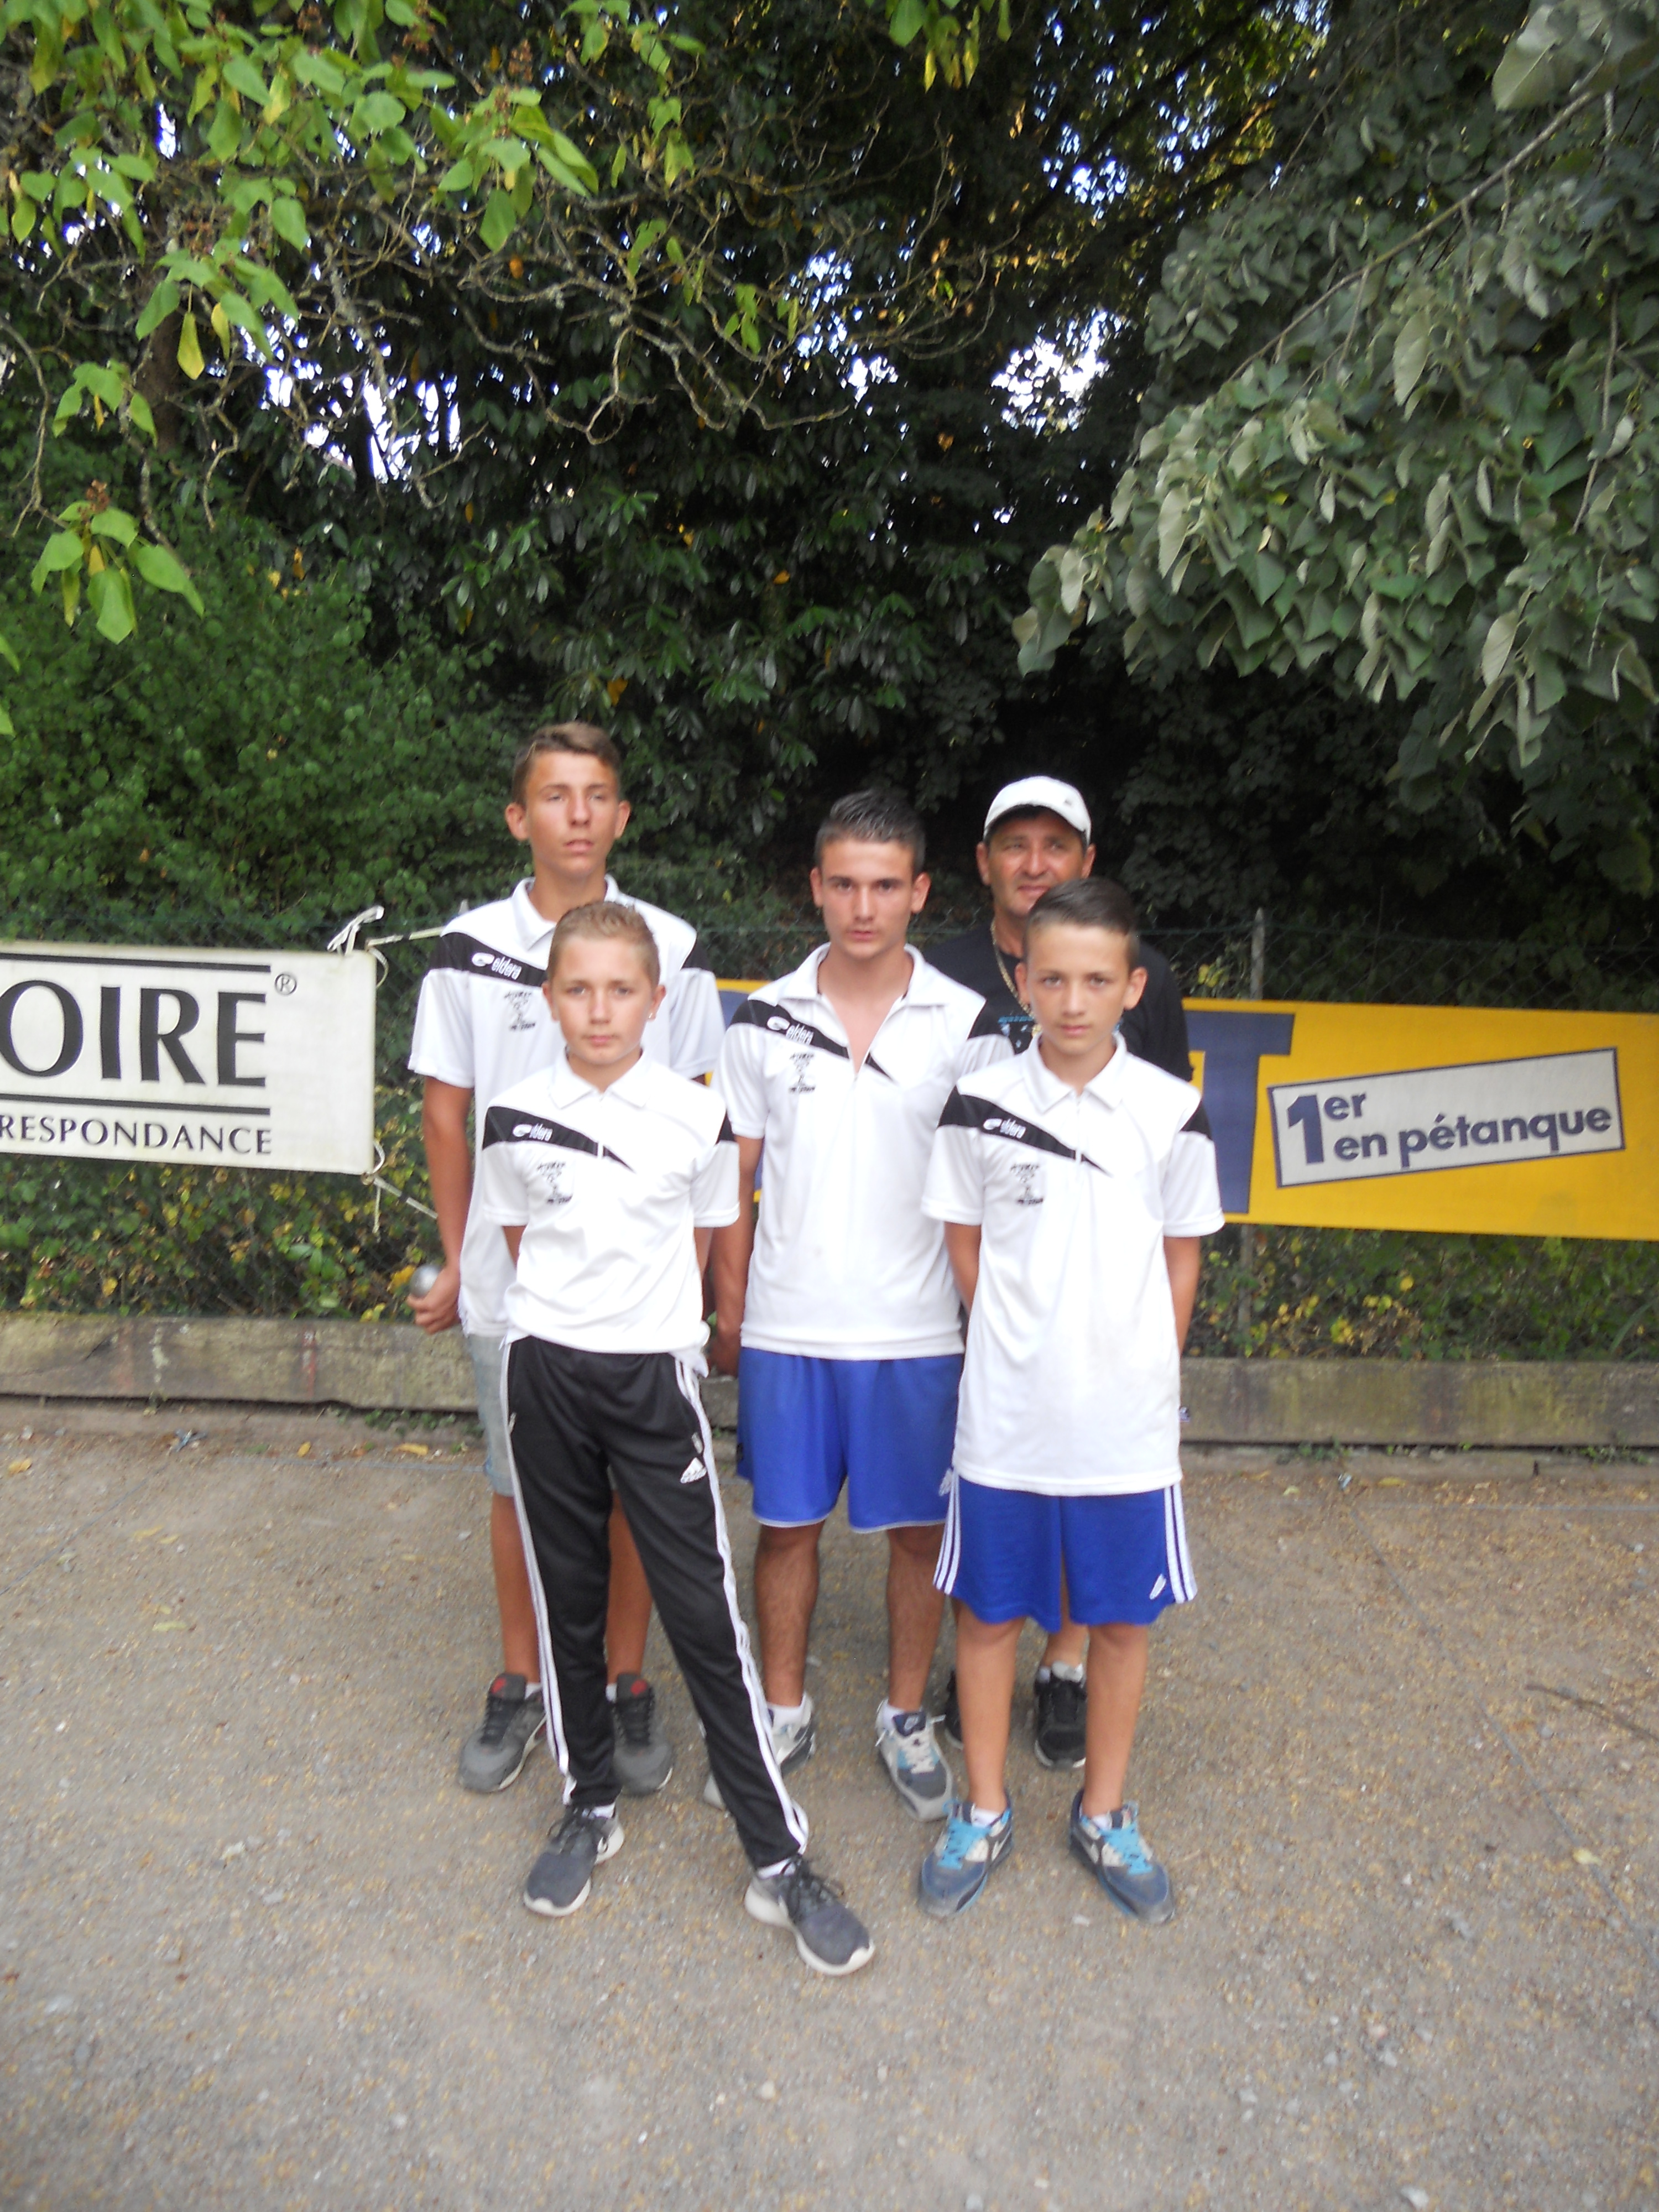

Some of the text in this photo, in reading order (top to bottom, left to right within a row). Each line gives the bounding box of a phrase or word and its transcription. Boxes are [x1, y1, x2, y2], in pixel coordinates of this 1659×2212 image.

[492, 956, 522, 980] eldera
[0, 1115, 272, 1155] RESPONDANCE
[1333, 1107, 1611, 1168] en pétanque
